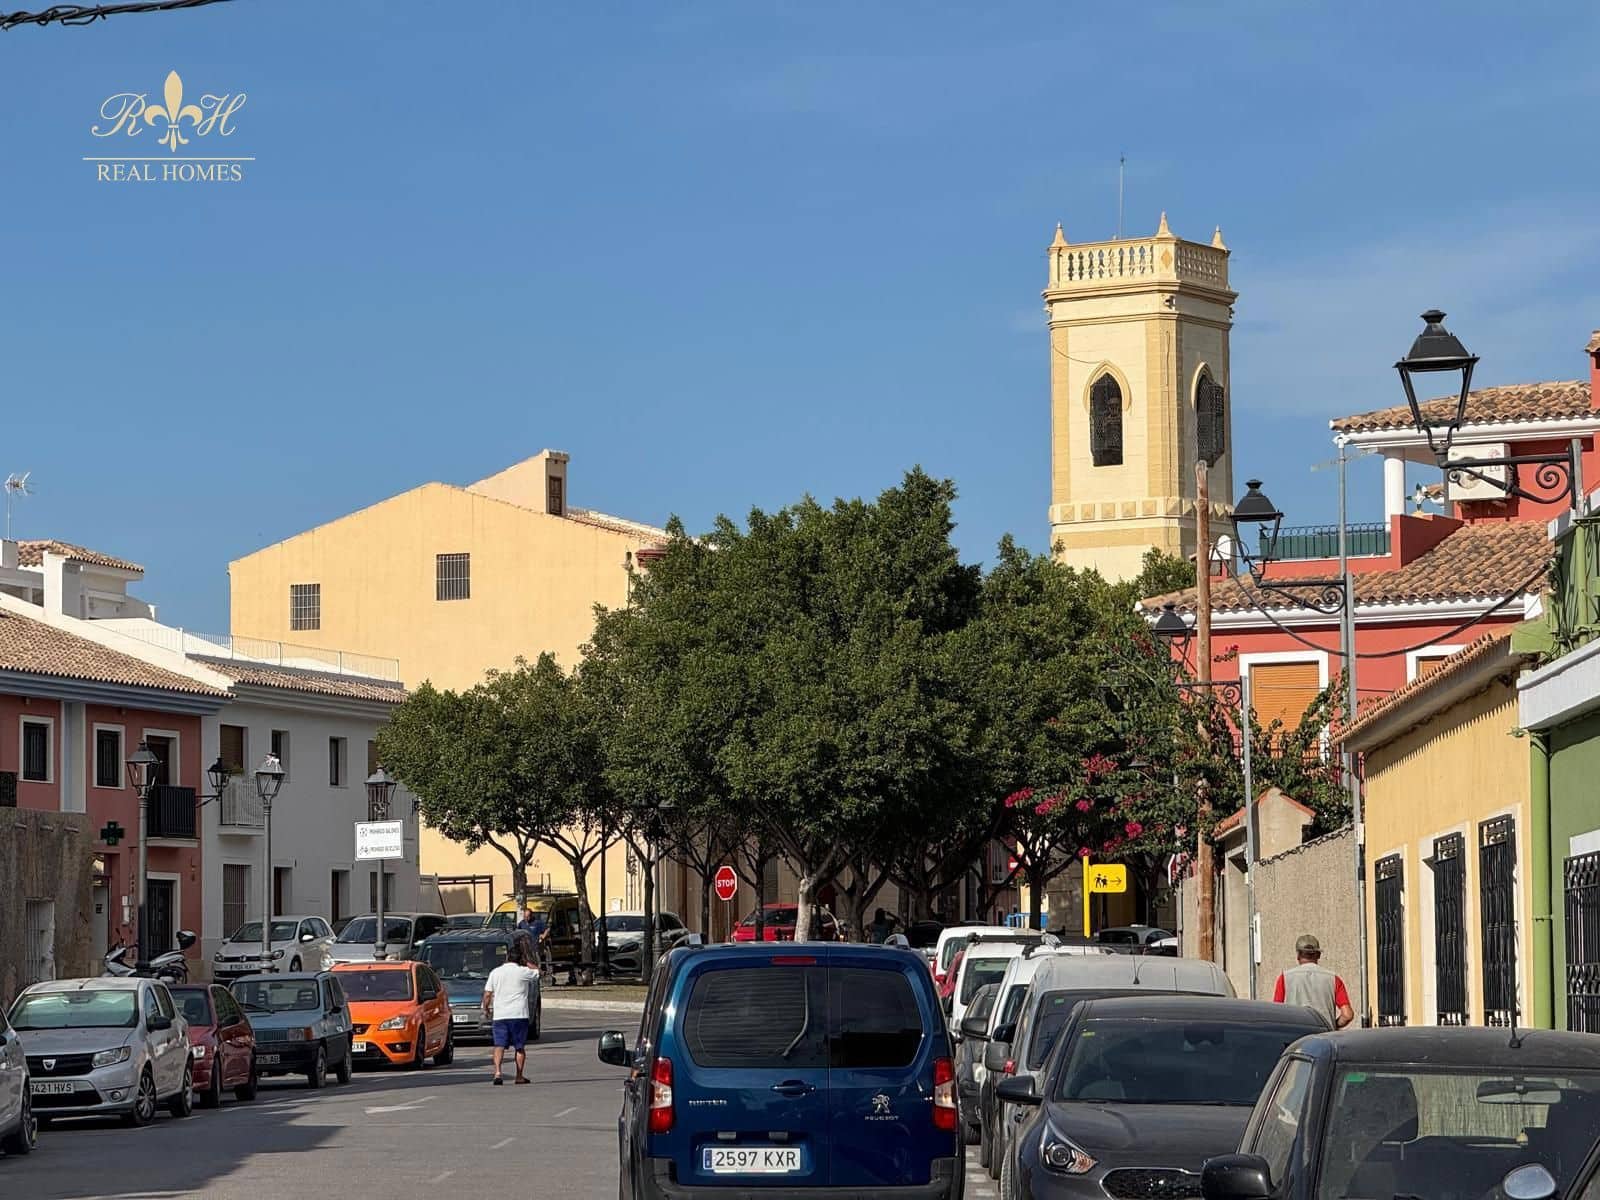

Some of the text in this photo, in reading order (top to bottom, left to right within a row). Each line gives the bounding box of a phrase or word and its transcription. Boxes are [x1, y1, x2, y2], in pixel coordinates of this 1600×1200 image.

[717, 879, 735, 888] STOP
[54, 1081, 73, 1092] HVS
[715, 1151, 796, 1167] 2597 KXR
